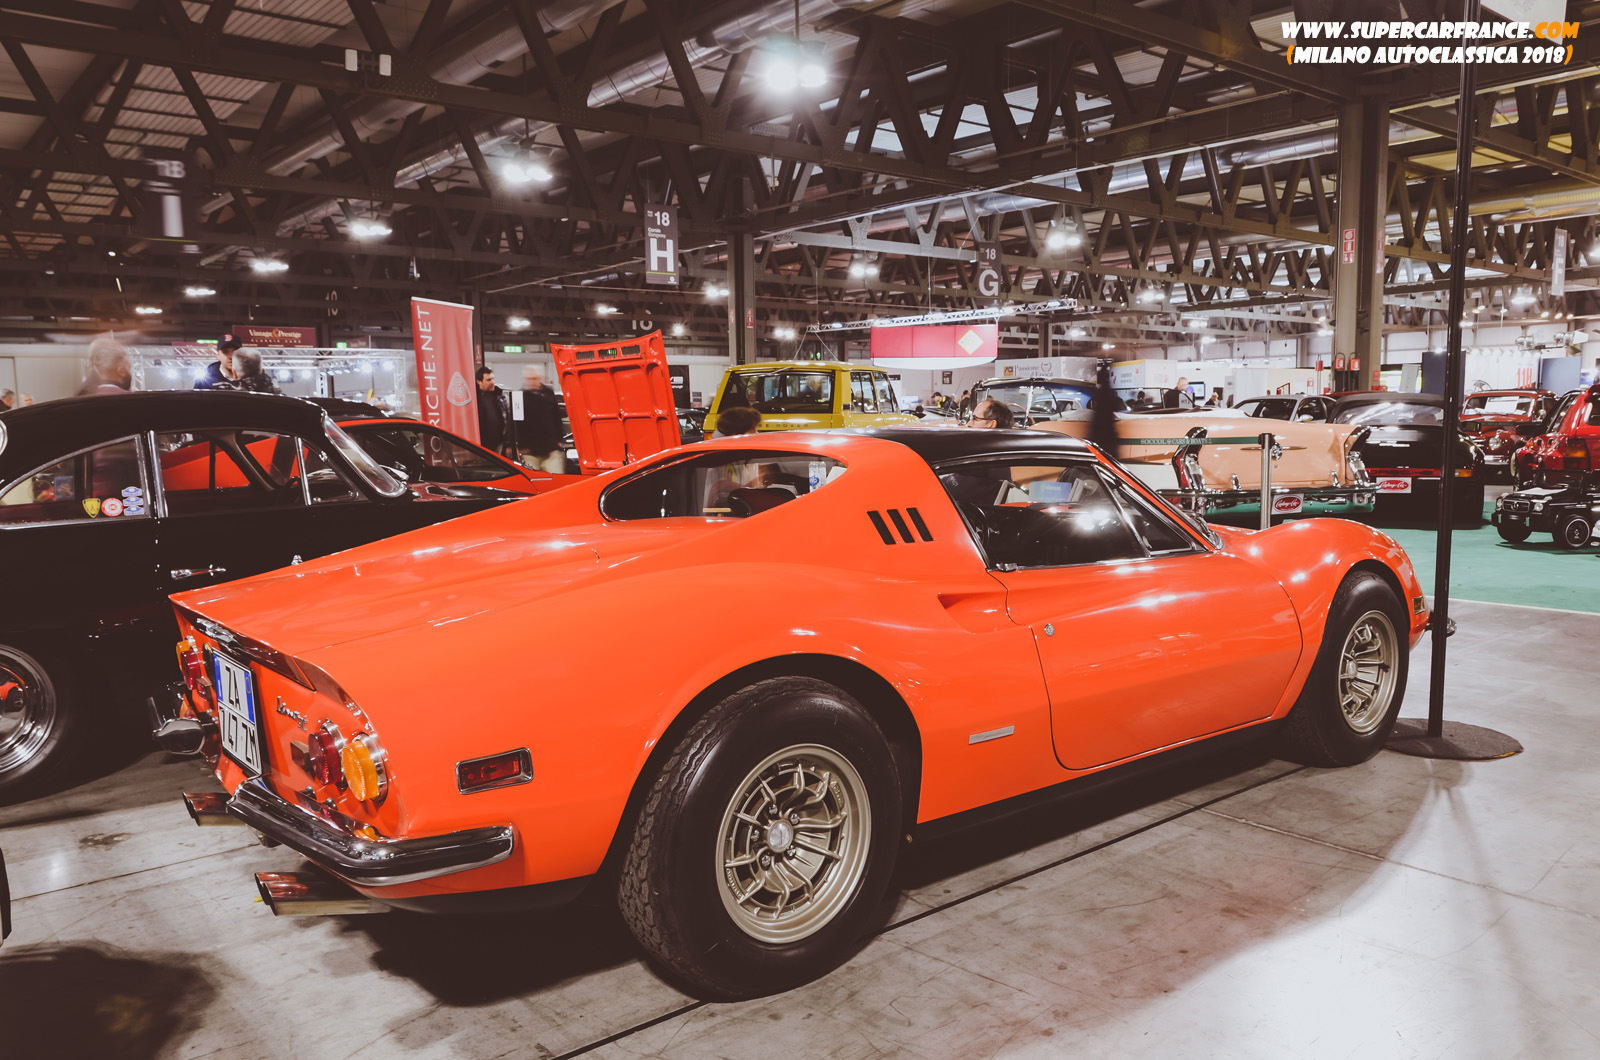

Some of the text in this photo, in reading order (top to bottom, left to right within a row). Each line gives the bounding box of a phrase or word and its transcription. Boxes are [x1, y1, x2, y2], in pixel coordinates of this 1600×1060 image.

[654, 210, 671, 227] 18
[649, 237, 675, 273] H
[985, 247, 997, 260] 18
[978, 269, 999, 297] G
[225, 665, 241, 711] ZA
